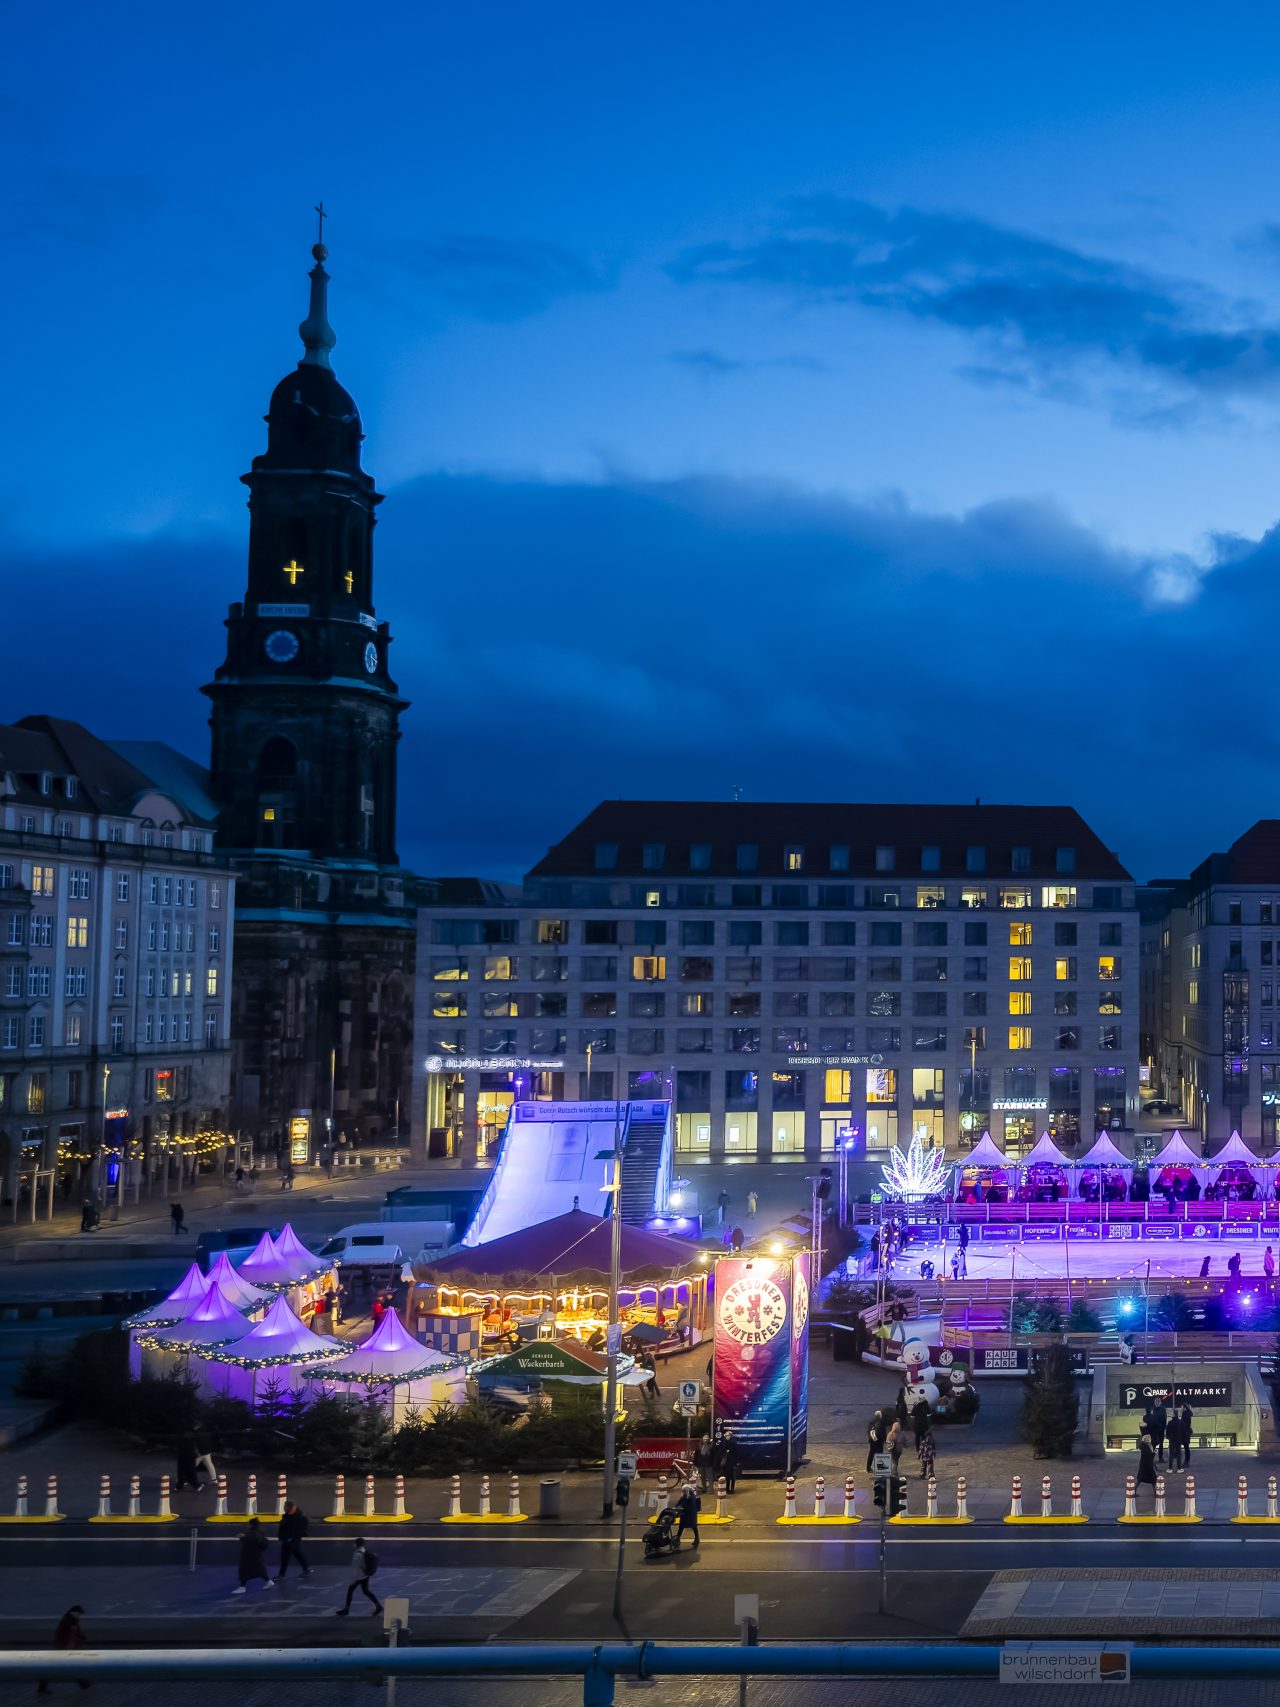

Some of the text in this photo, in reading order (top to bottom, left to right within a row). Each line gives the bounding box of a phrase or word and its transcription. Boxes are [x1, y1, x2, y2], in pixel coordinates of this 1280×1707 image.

[992, 1102, 1047, 1110] STARBUCKS
[726, 1280, 781, 1303] DRESDNER
[723, 1313, 783, 1342] WINTERFEST
[518, 1358, 565, 1368] Wackerbarth
[1176, 1388, 1227, 1396] ALTMARKT
[1002, 1652, 1097, 1665] brunnenbau
[1015, 1667, 1097, 1680] wilschdorf
